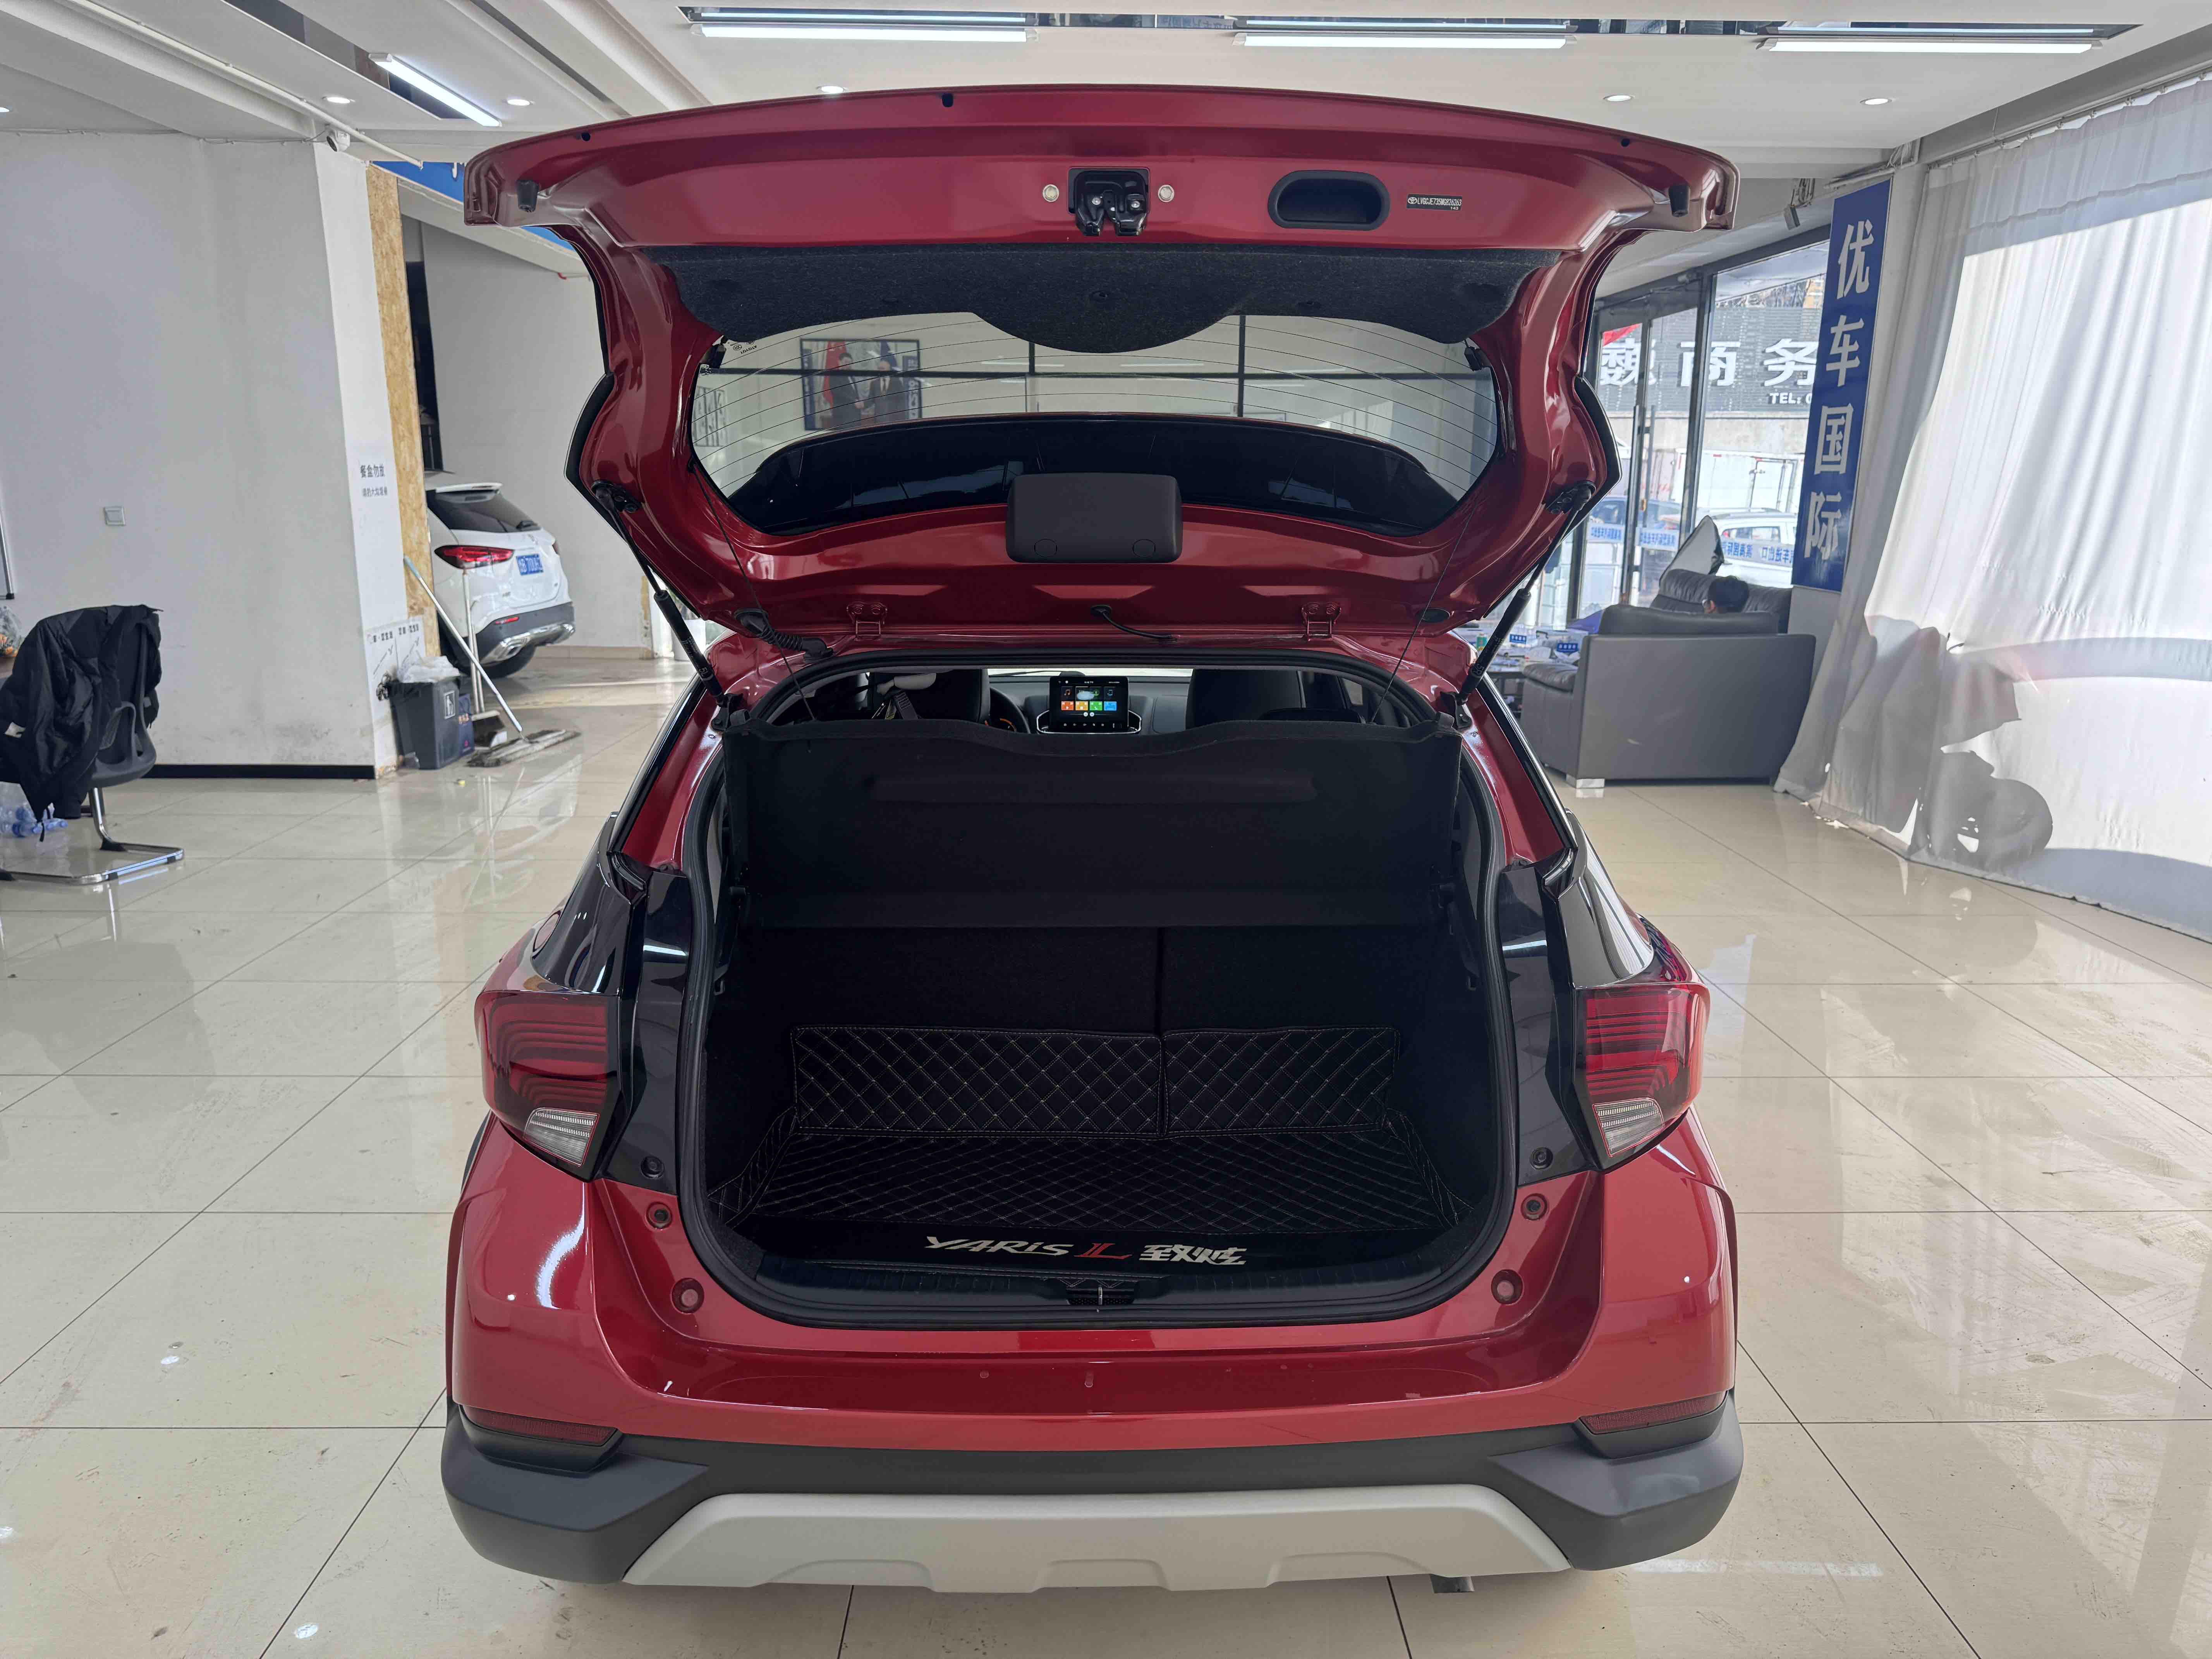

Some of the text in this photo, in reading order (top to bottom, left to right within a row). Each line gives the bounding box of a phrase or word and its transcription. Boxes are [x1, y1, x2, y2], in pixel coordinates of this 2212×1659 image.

[1769, 392, 1801, 404] TEL:
[1804, 219, 1874, 560] 优车国际
[1139, 1244, 1247, 1265] 致炫
